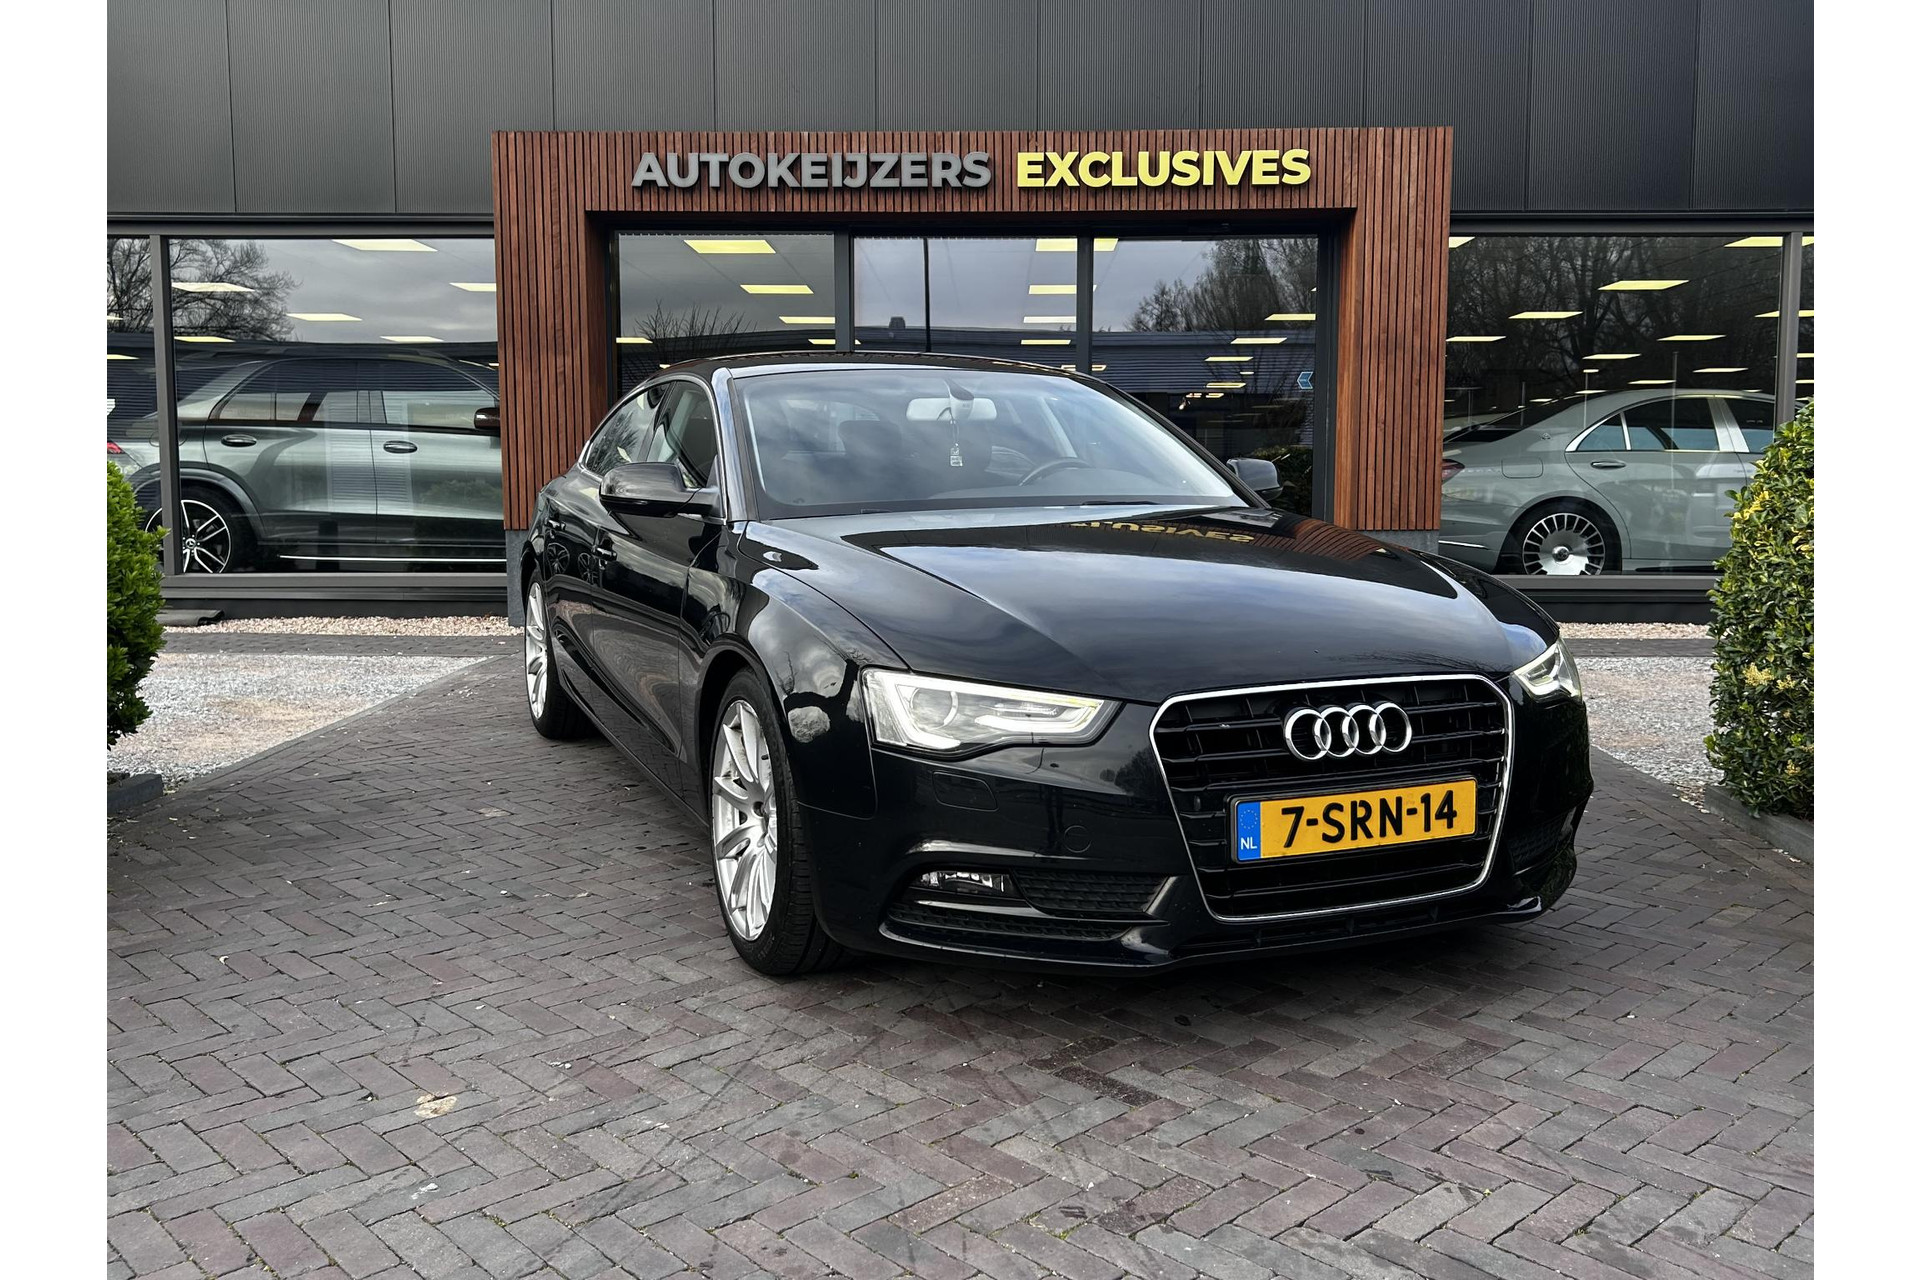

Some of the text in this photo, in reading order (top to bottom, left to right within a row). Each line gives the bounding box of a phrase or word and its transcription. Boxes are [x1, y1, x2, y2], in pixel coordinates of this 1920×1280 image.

[631, 148, 1311, 189] AUTOKEIJZERS EXCLUSIVES
[1281, 790, 1458, 848] 7-SRN-14
[1240, 837, 1258, 851] NL
